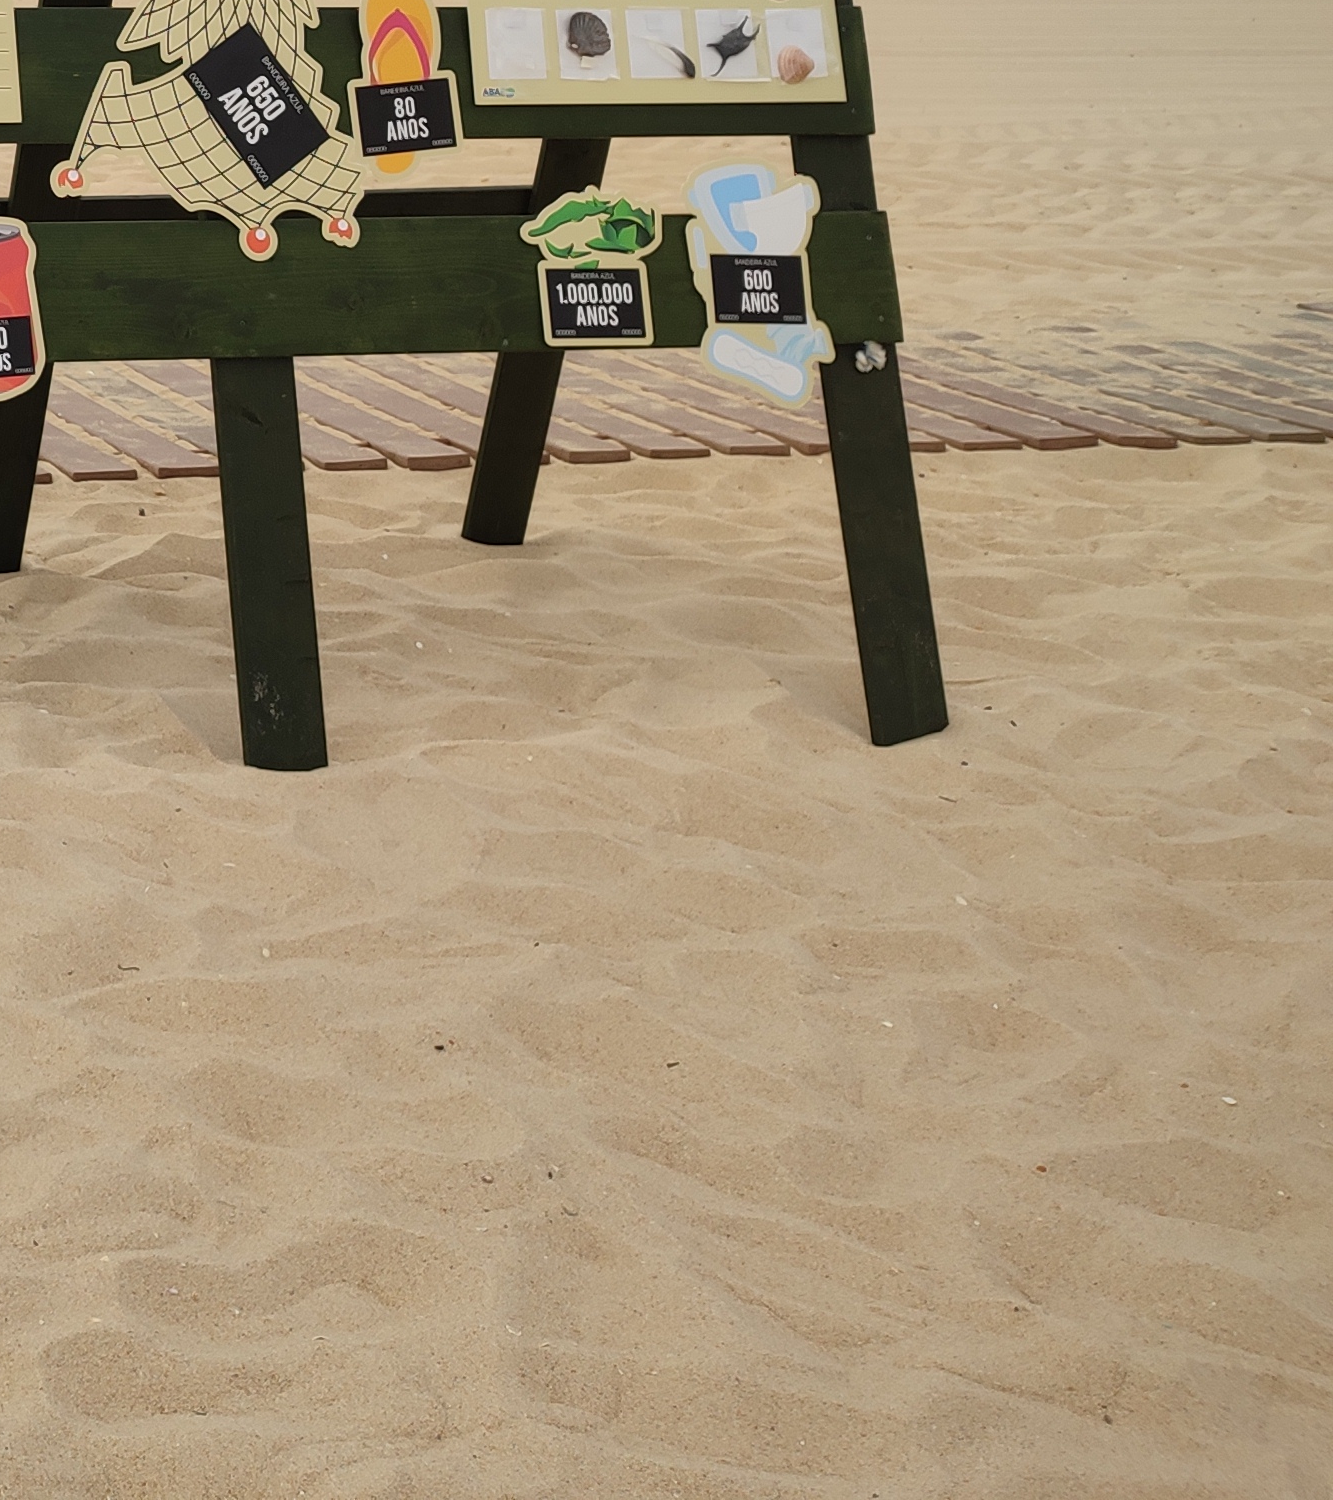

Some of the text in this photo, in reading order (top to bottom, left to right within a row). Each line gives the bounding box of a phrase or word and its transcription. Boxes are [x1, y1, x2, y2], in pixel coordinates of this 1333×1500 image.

[261, 55, 304, 115] BANDEIRA AZUL
[245, 75, 287, 122] 650
[394, 96, 416, 117] 80
[217, 87, 269, 145] ANOS
[386, 117, 430, 142] ANOS
[744, 269, 772, 290] 600
[556, 282, 633, 305] 1.000.000
[741, 291, 780, 314] ANOS
[576, 305, 619, 327] ANOS
